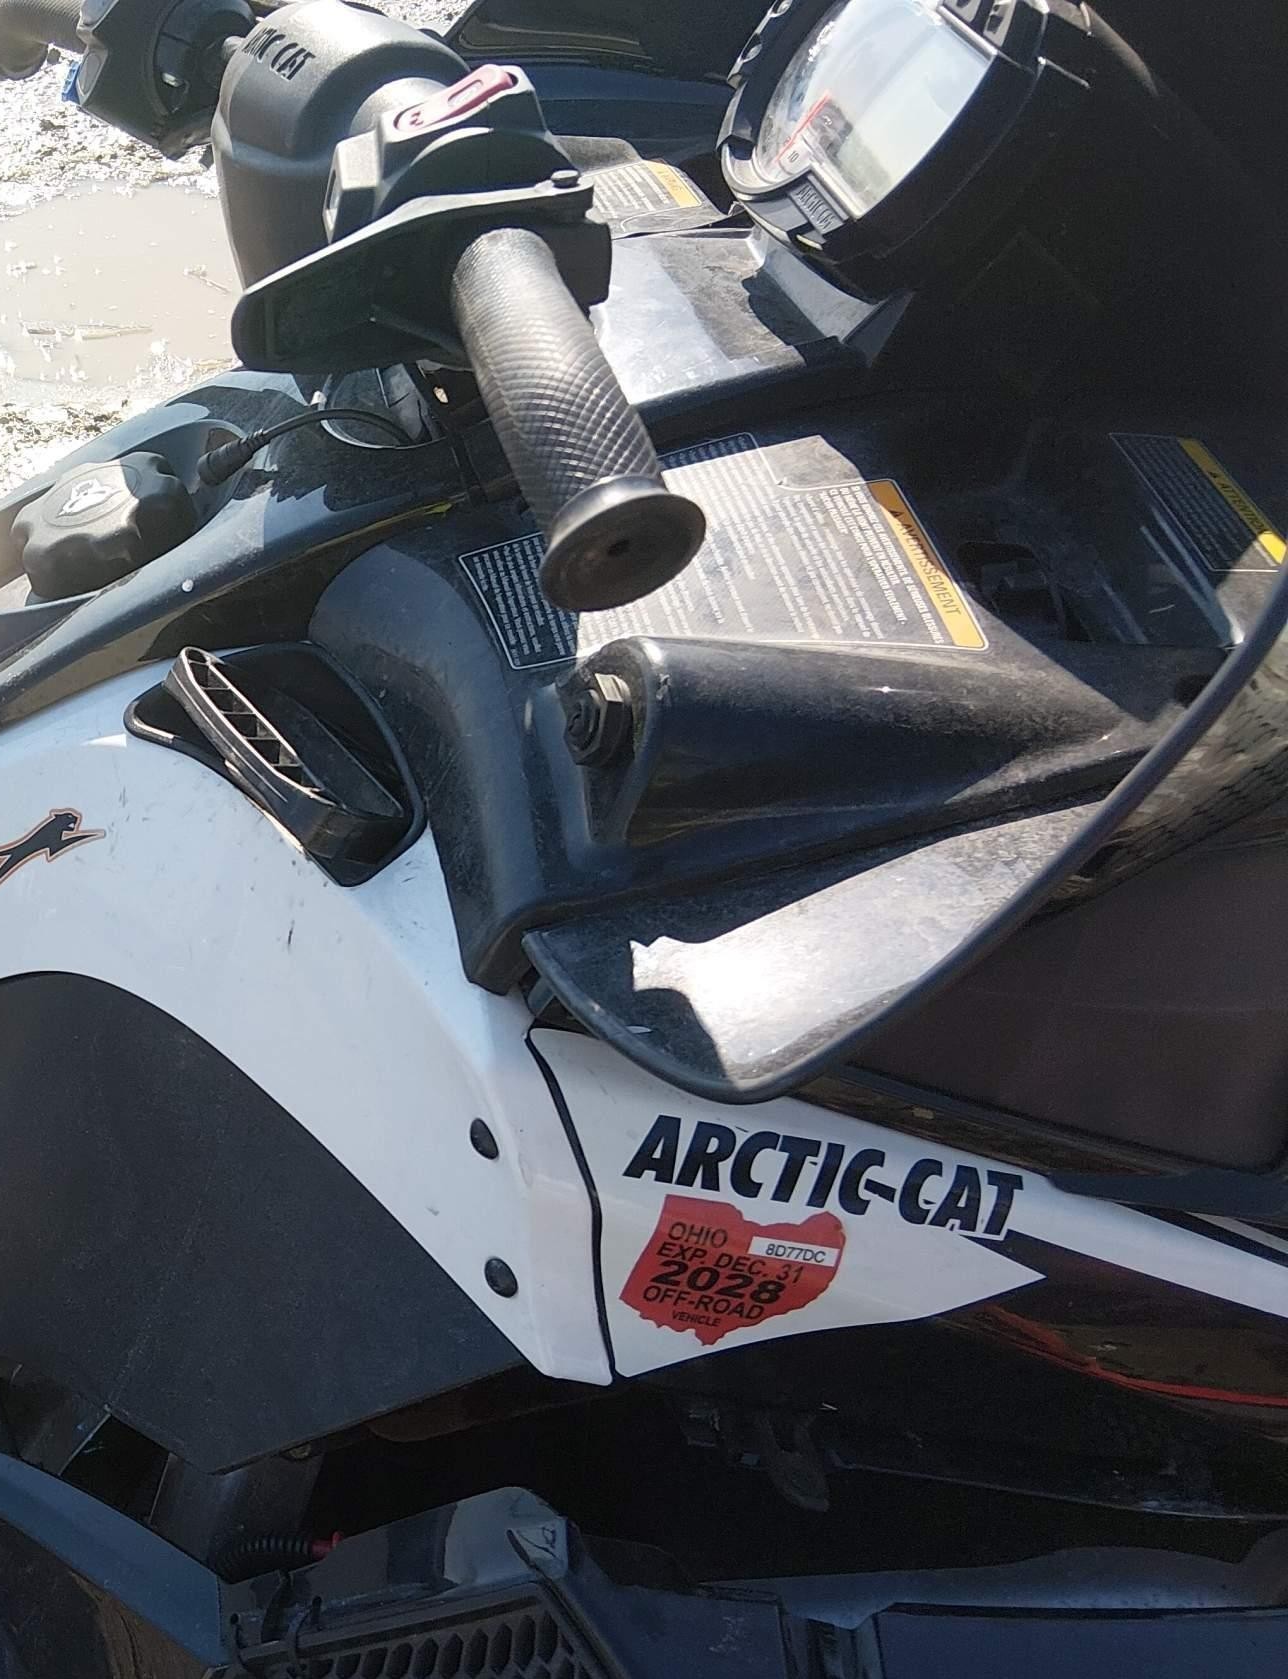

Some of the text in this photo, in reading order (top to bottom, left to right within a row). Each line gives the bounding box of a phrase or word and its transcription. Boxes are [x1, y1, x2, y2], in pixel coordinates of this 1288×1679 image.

[271, 42, 316, 81] CAT
[899, 523, 961, 616] AVERTISSEMENT
[668, 1221, 729, 1248] OHIO
[765, 1243, 827, 1263] 8D77DC
[657, 1242, 803, 1284] EXP. DEC. 31
[650, 1260, 787, 1304] 2028
[642, 1285, 765, 1321] OFF-ROAD
[671, 1311, 721, 1327] VEHICLE
